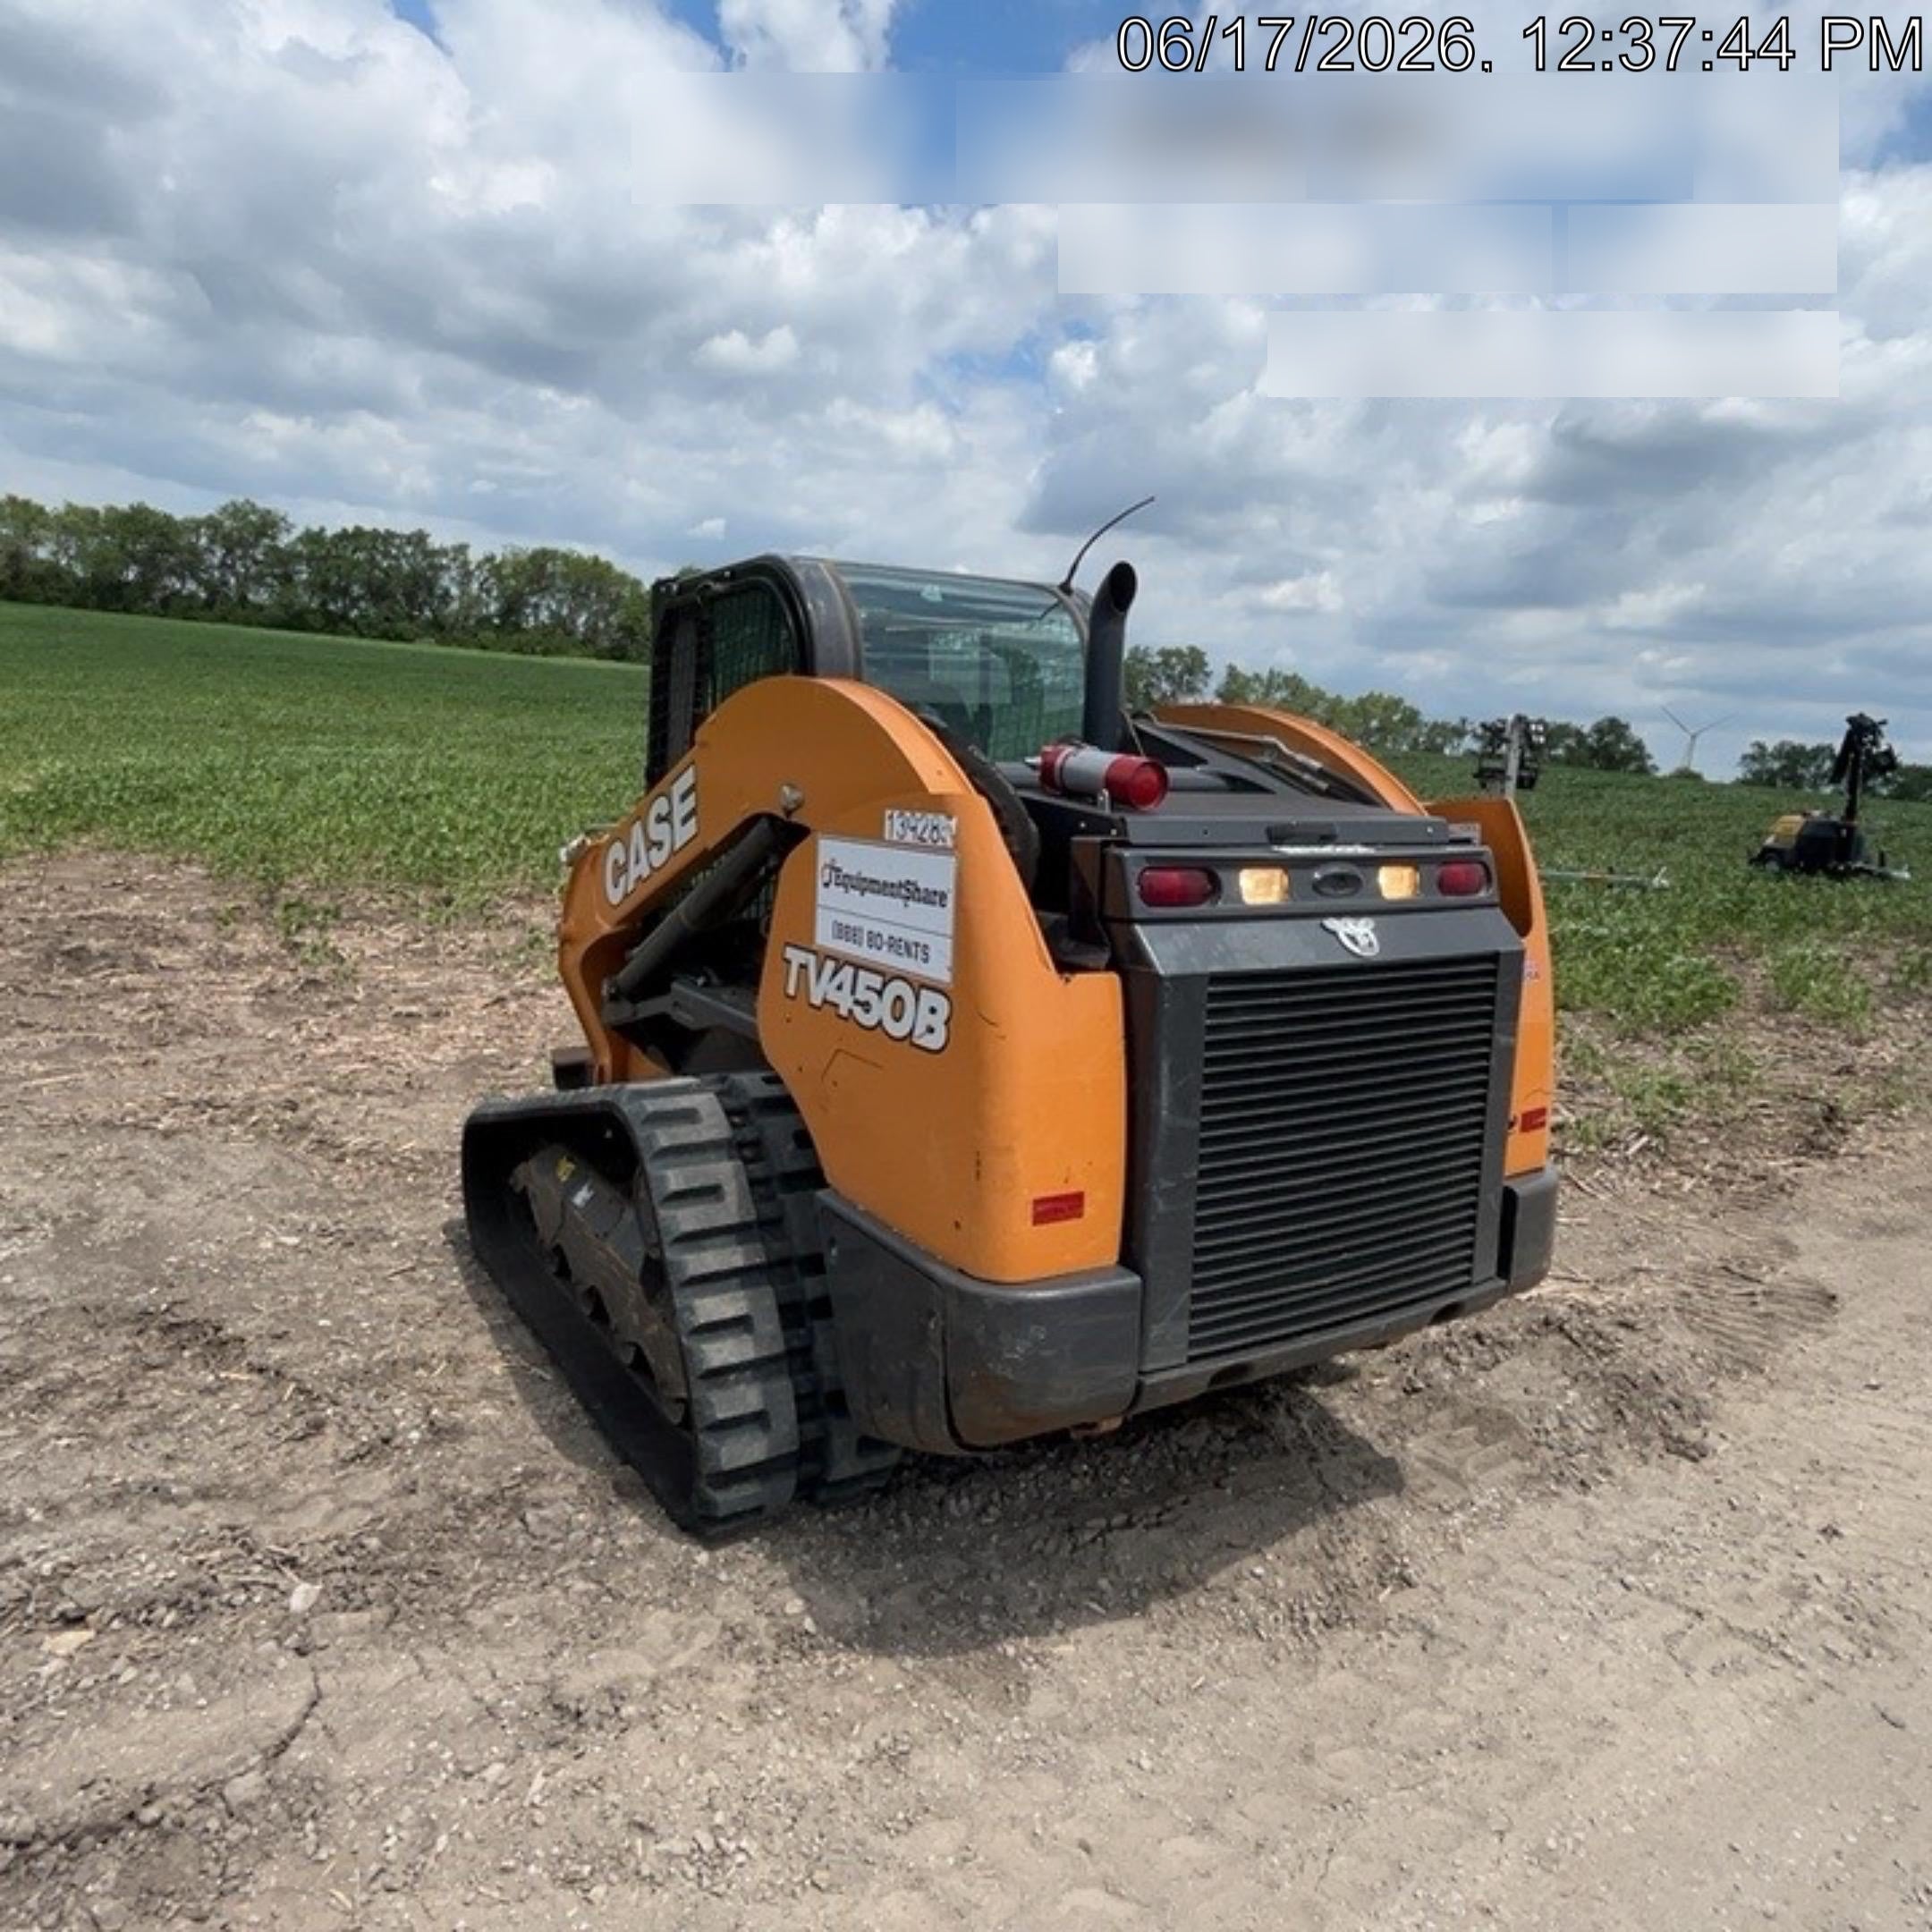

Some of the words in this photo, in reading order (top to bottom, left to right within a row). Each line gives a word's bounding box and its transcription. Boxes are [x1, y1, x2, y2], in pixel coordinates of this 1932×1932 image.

[605, 763, 699, 906] CASE
[833, 865, 948, 908] EquipmentShare
[784, 945, 953, 1054] TV450B
